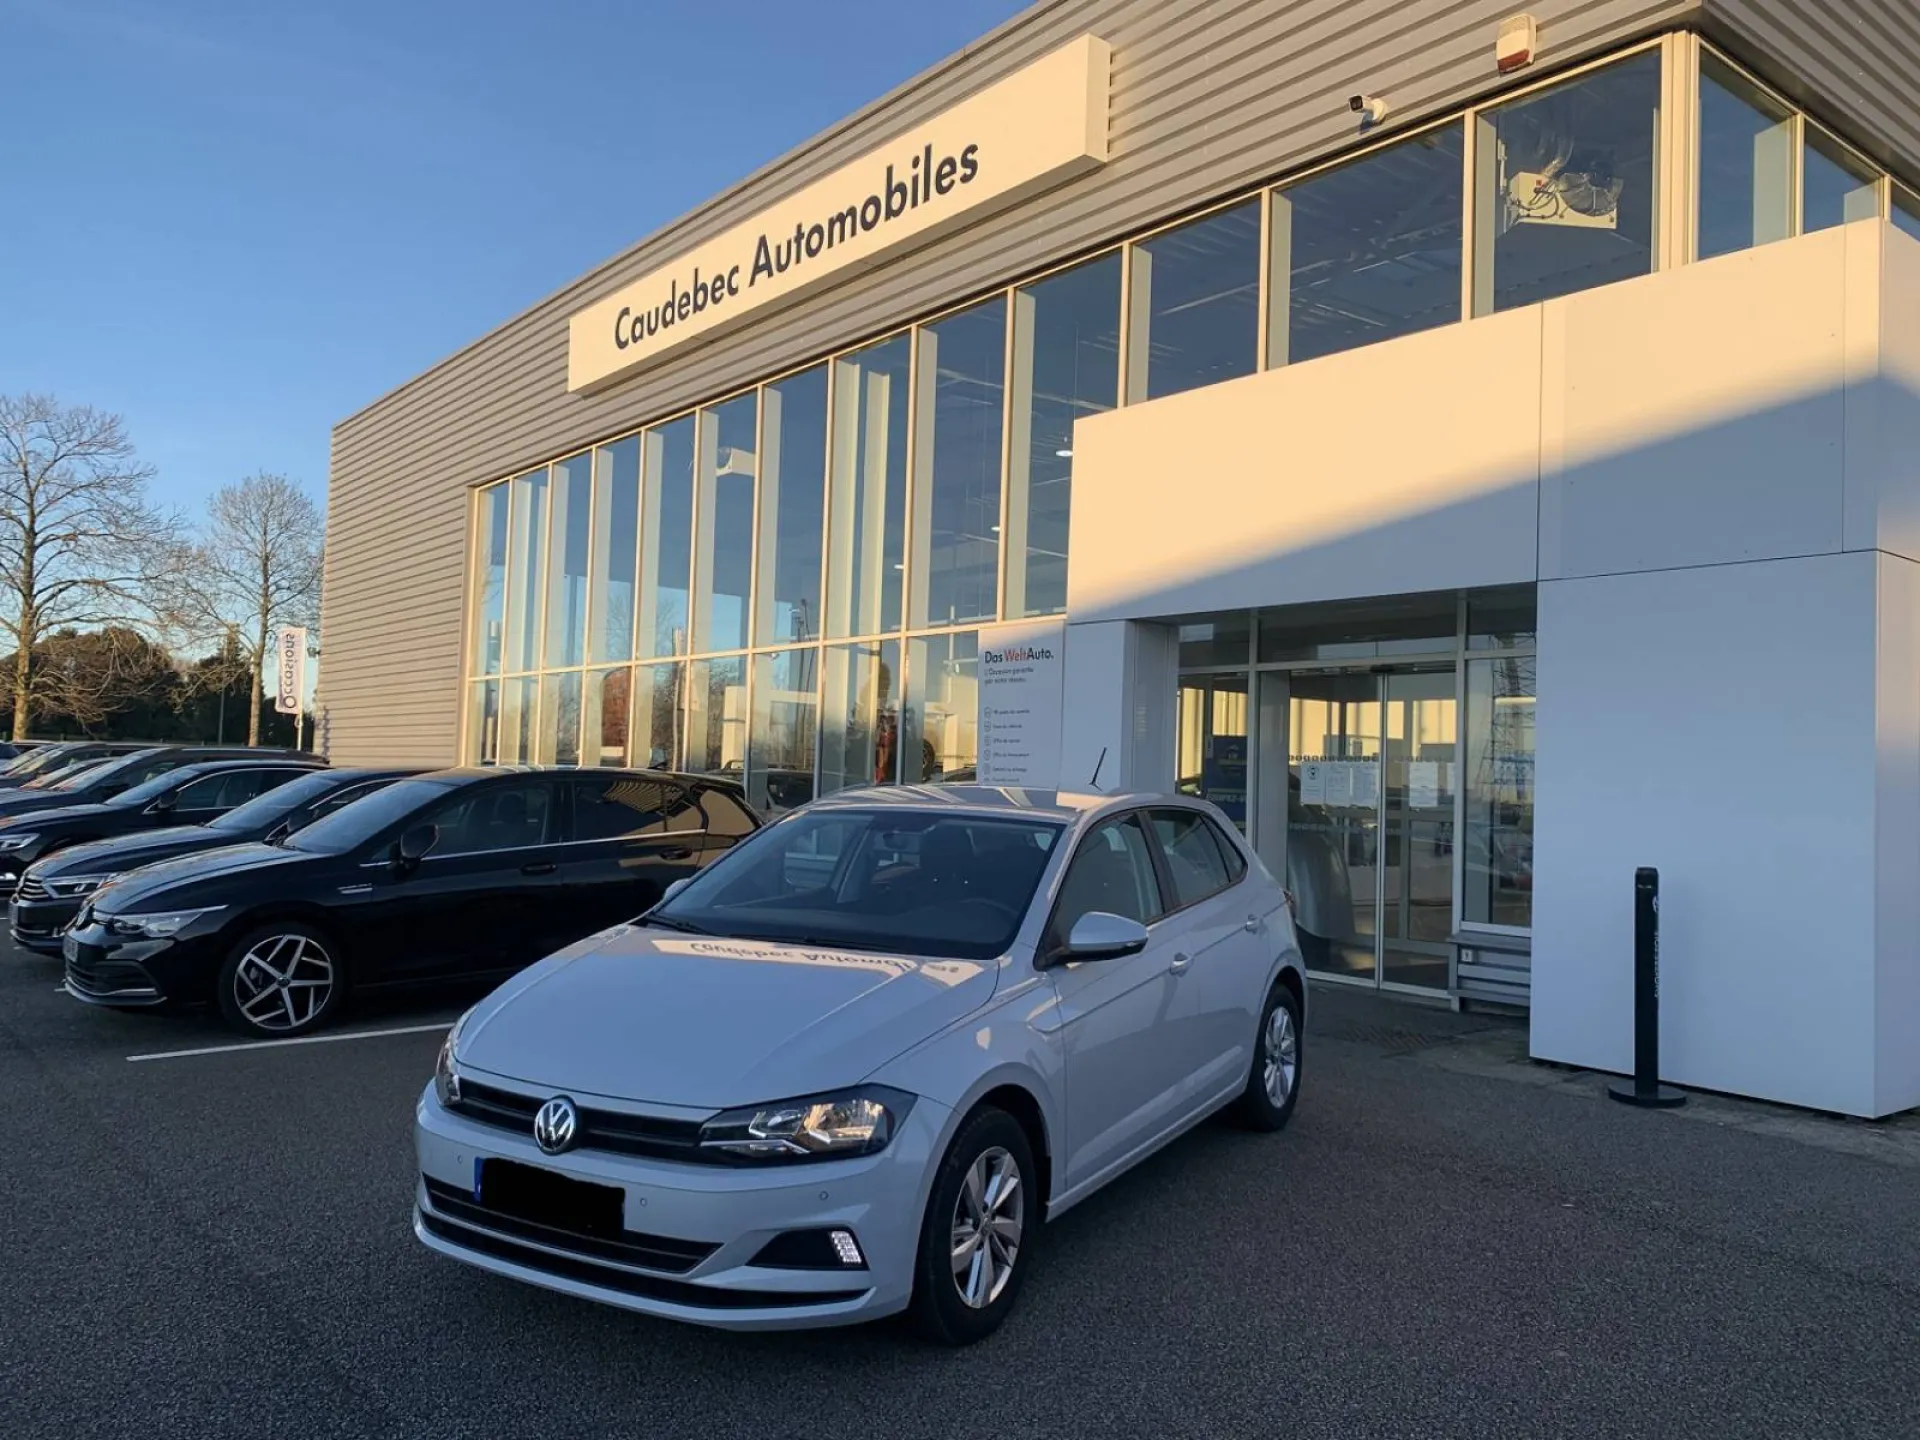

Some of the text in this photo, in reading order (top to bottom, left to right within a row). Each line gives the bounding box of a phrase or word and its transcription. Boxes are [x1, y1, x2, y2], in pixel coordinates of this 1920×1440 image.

[614, 142, 980, 350] Caudebec Automobiles
[984, 651, 1003, 664] Das
